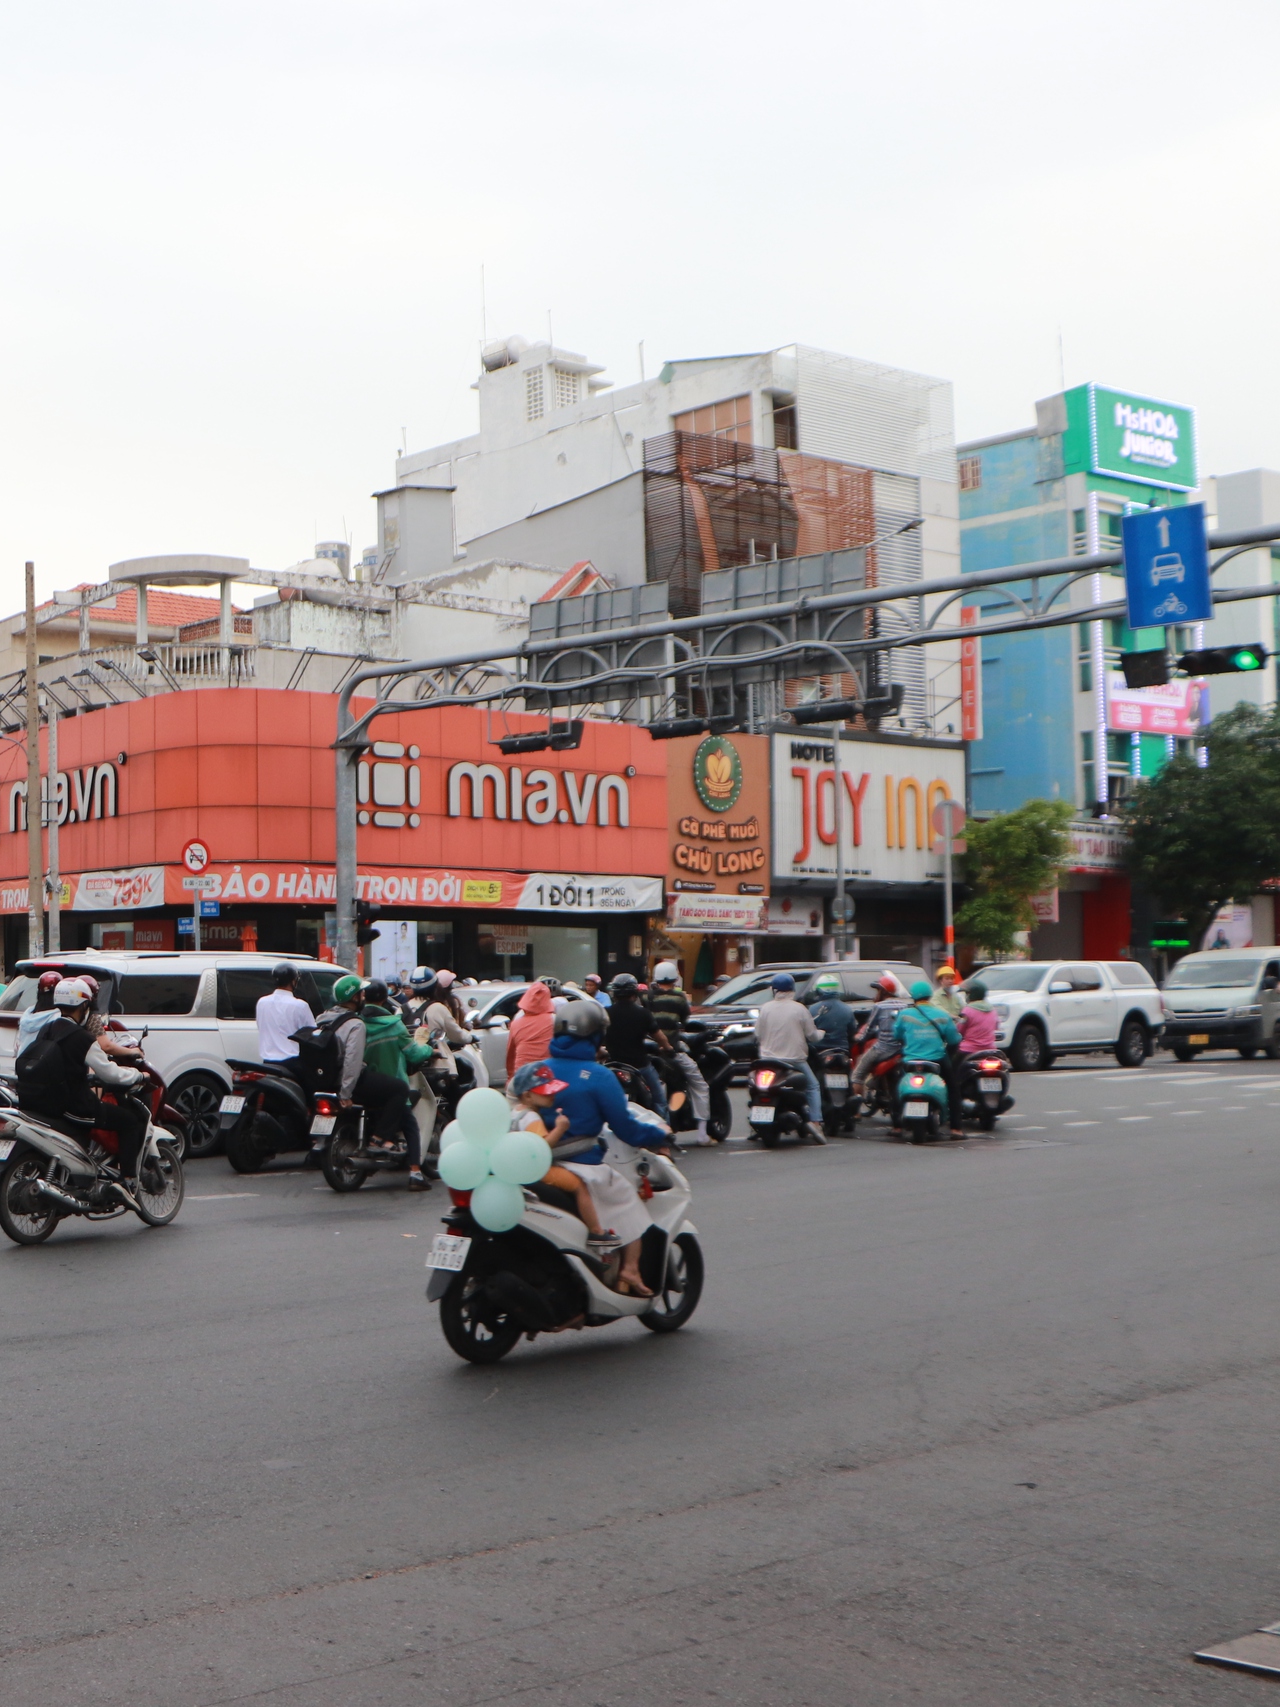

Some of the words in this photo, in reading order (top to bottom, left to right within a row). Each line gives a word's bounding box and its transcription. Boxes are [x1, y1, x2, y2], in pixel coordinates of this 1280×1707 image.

[790, 741, 836, 764] HOTE
[448, 761, 629, 828] mia.vn
[717, 848, 765, 873] LONG
[202, 865, 270, 899] BẢO
[358, 875, 418, 904] TRỌN
[422, 873, 461, 902] ĐỜI
[549, 876, 582, 906] ĐỔI
[496, 942, 526, 953] ESCAPE
